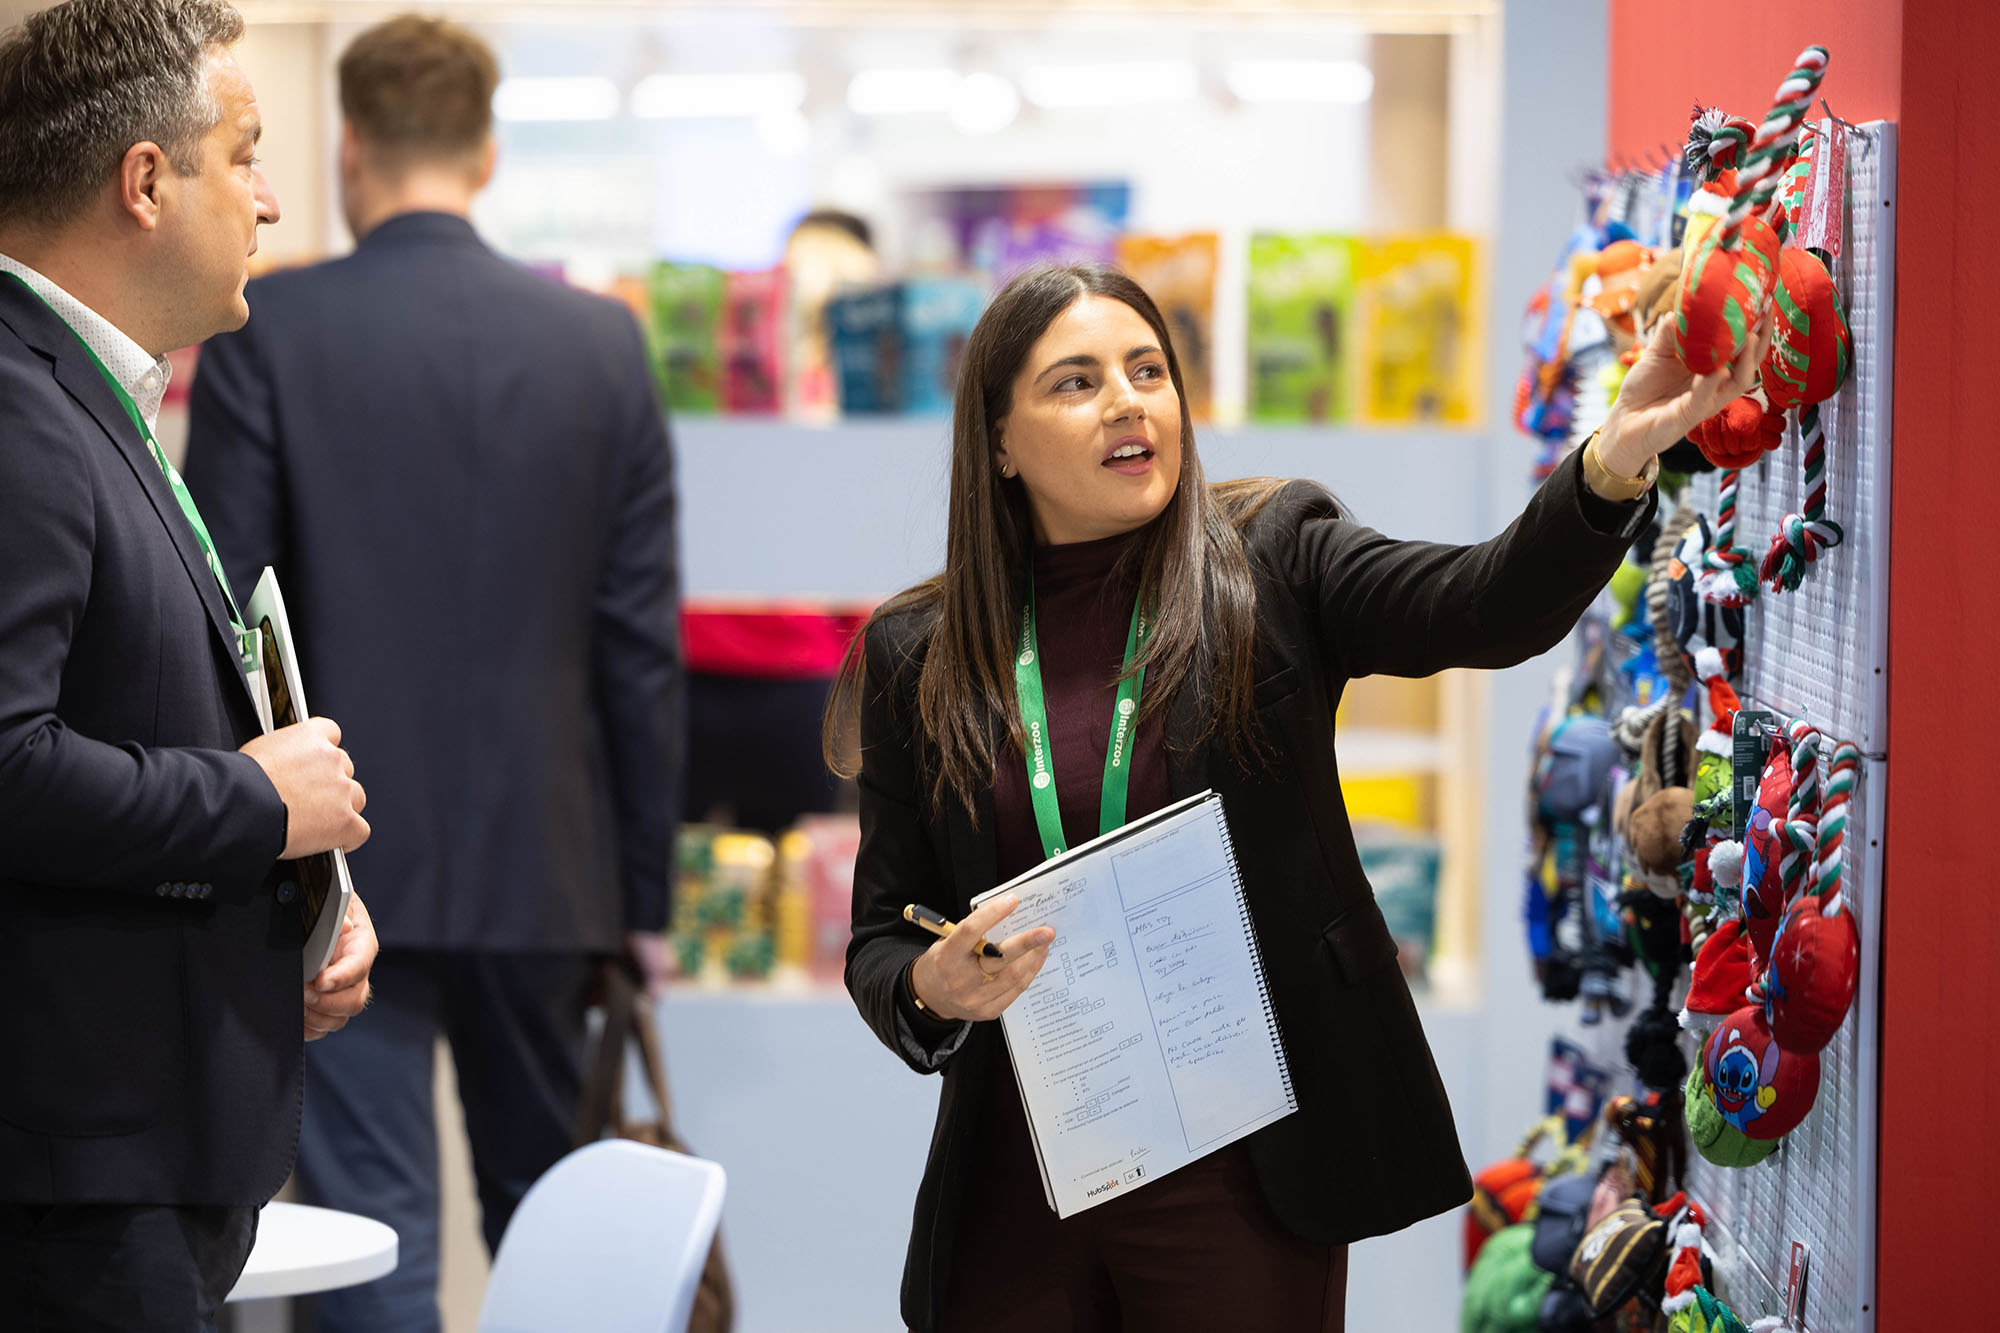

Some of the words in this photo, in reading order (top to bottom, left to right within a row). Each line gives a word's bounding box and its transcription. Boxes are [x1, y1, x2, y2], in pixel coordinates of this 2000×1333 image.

[1022, 604, 1030, 651] Interzoo
[1030, 721, 1045, 773] Interzoo
[1113, 714, 1130, 767] Interzoo
[1087, 1180, 1119, 1198] HubSpot
